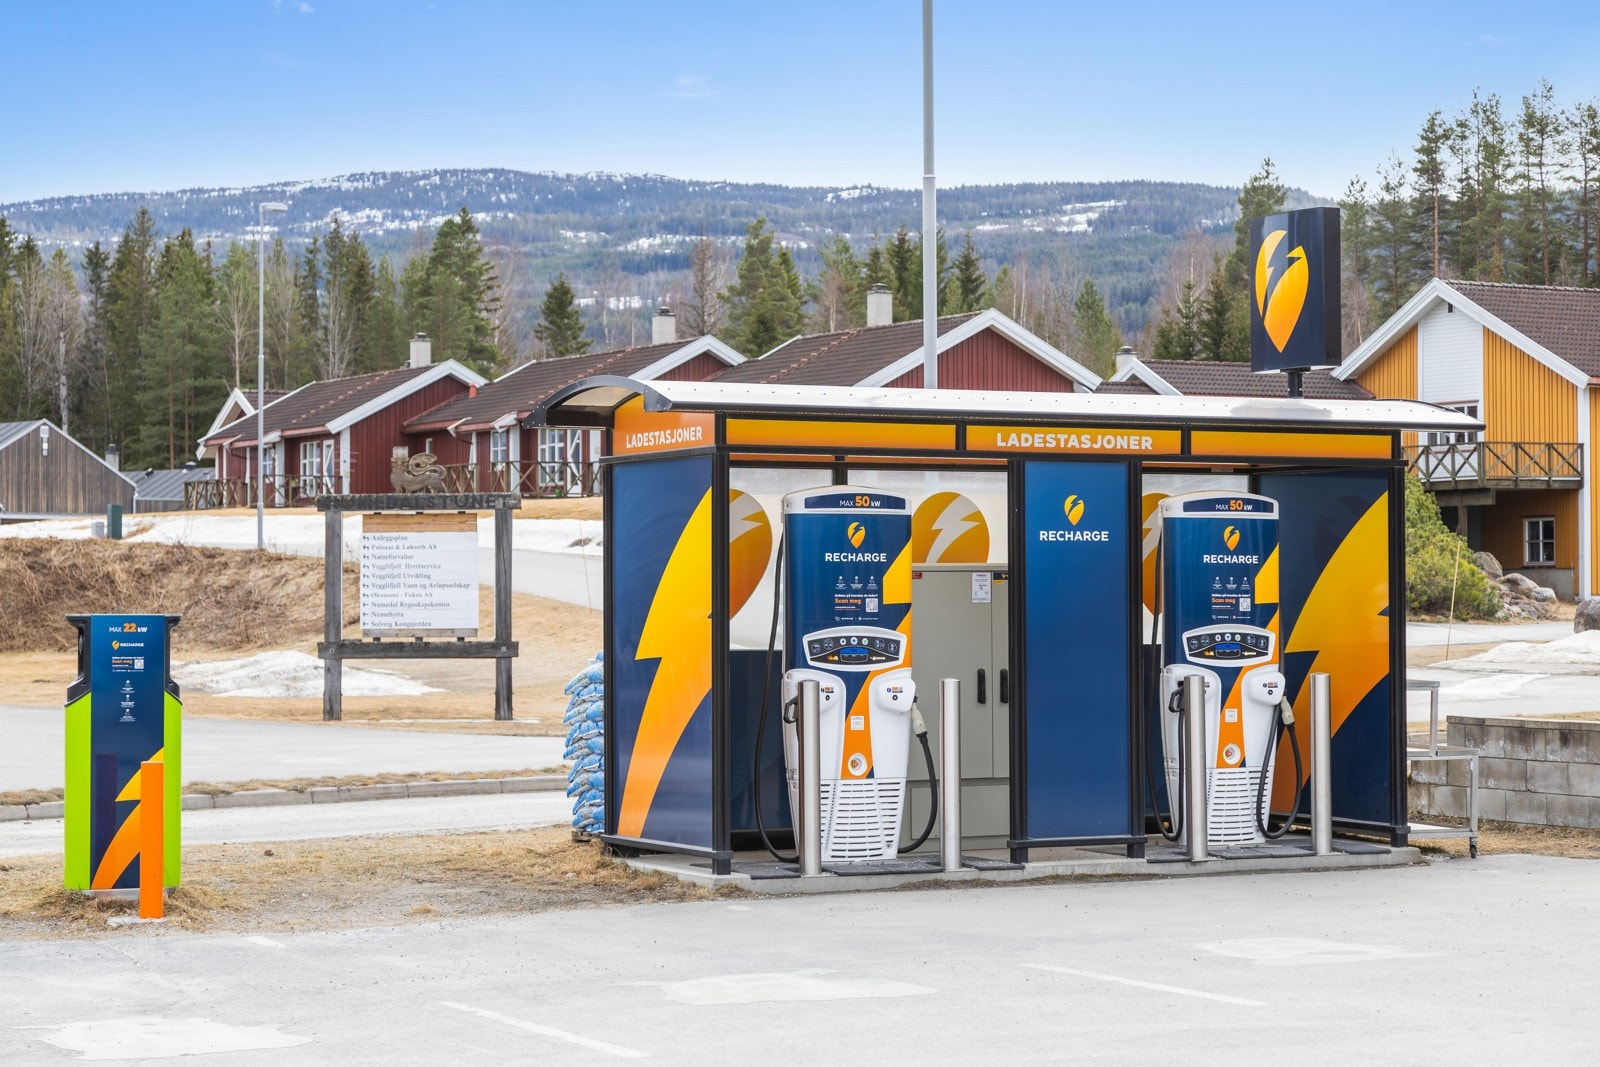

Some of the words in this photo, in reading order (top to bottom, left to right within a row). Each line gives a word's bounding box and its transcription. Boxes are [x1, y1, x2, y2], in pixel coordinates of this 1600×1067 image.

[625, 426, 703, 449] LADESTASJONER
[996, 432, 1153, 450] LADESTASJONER
[855, 495, 870, 507] 50
[1229, 500, 1244, 511] 50
[1039, 530, 1109, 542] RECHARGE
[825, 552, 887, 562] RECHARGE
[1203, 554, 1259, 564] RECHARGE
[428, 582, 470, 590] Avløpsselskap
[123, 623, 137, 633] 22
